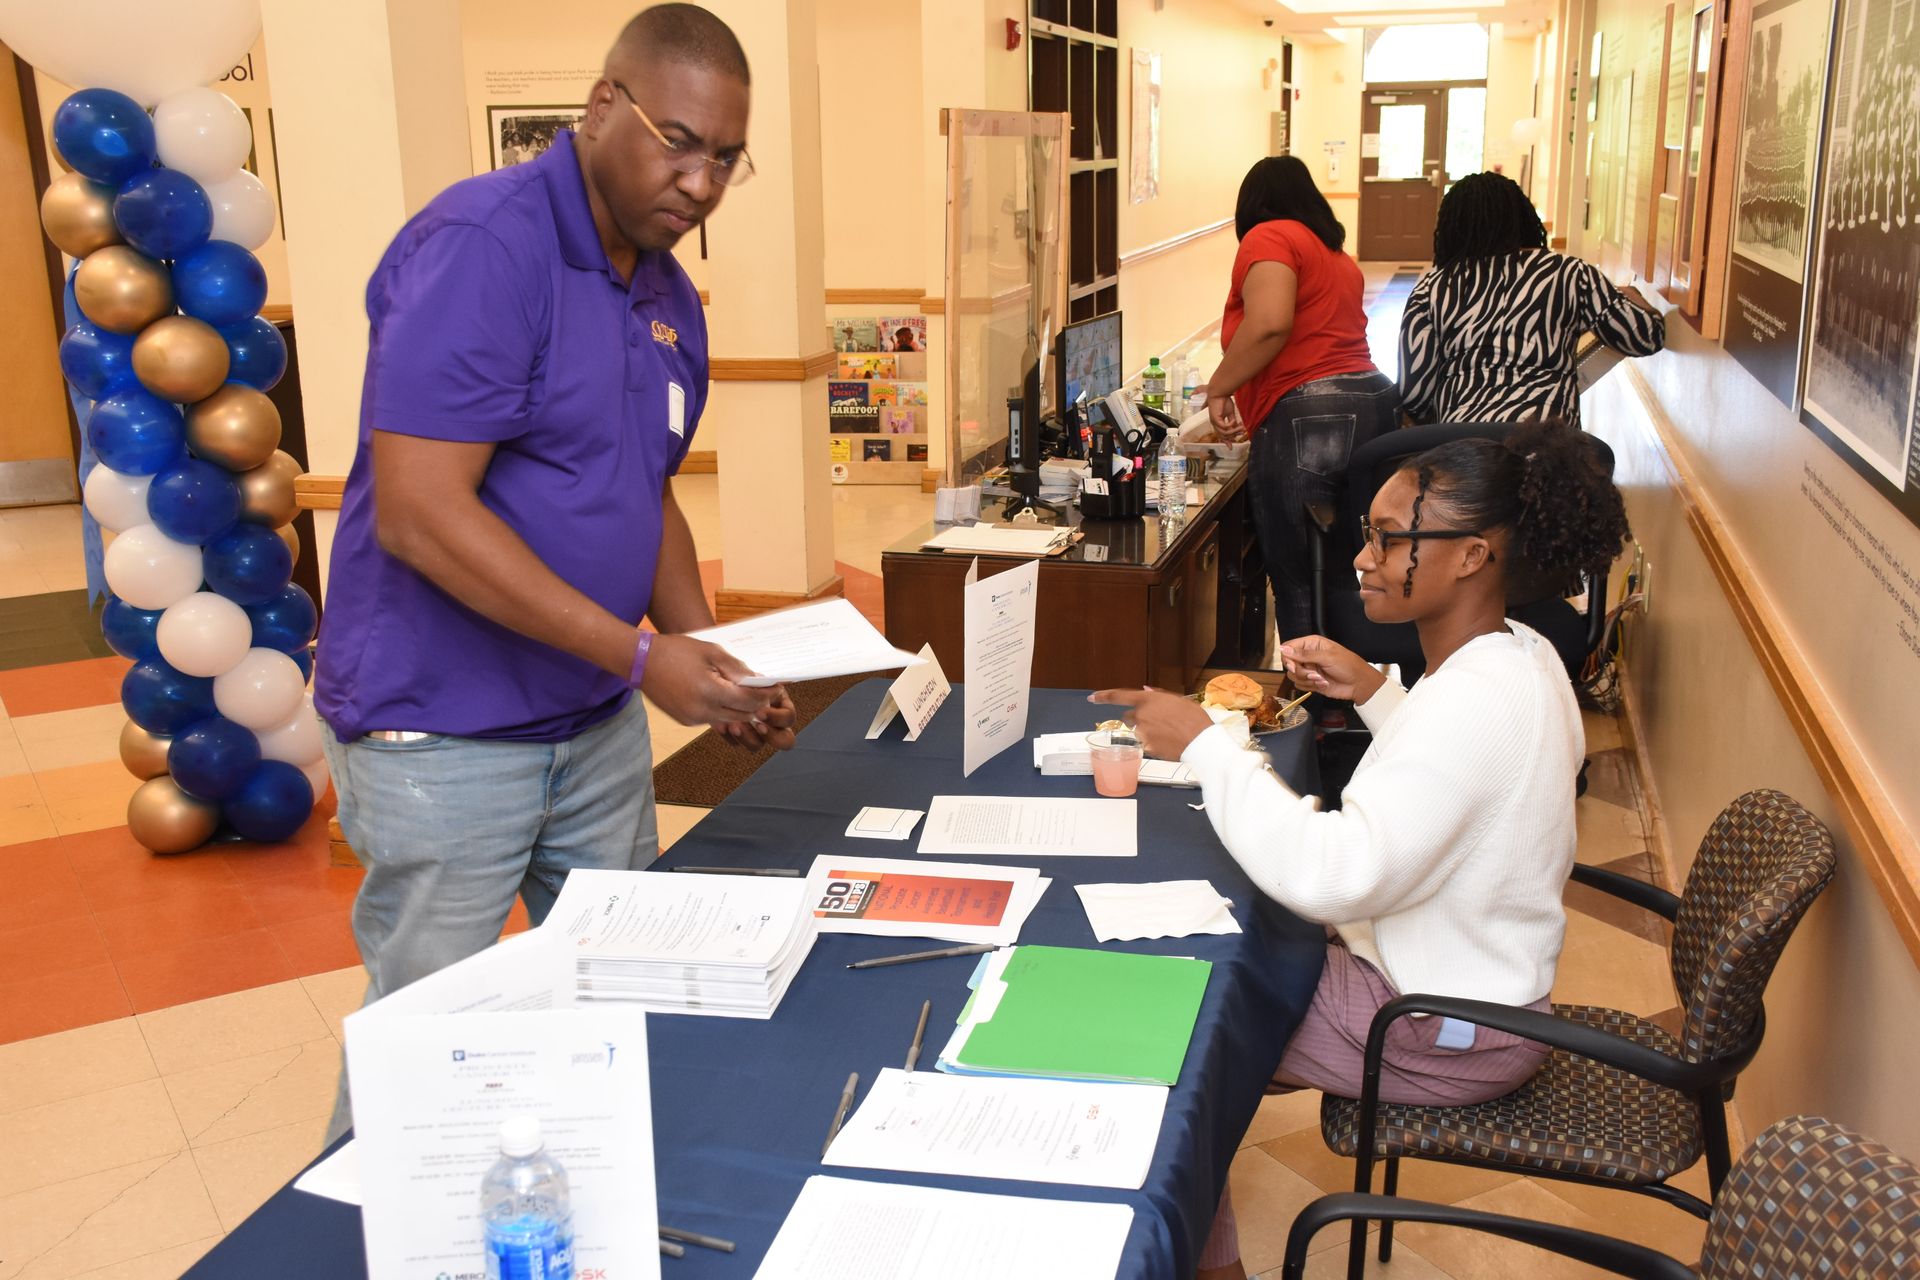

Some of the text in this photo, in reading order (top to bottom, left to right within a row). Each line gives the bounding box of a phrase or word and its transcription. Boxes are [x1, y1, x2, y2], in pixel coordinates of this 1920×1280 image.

[830, 406, 879, 414] BAREFOOT
[912, 677, 937, 712] LUNCHEON
[818, 881, 851, 910] 50
[576, 1268, 608, 1280] SK
